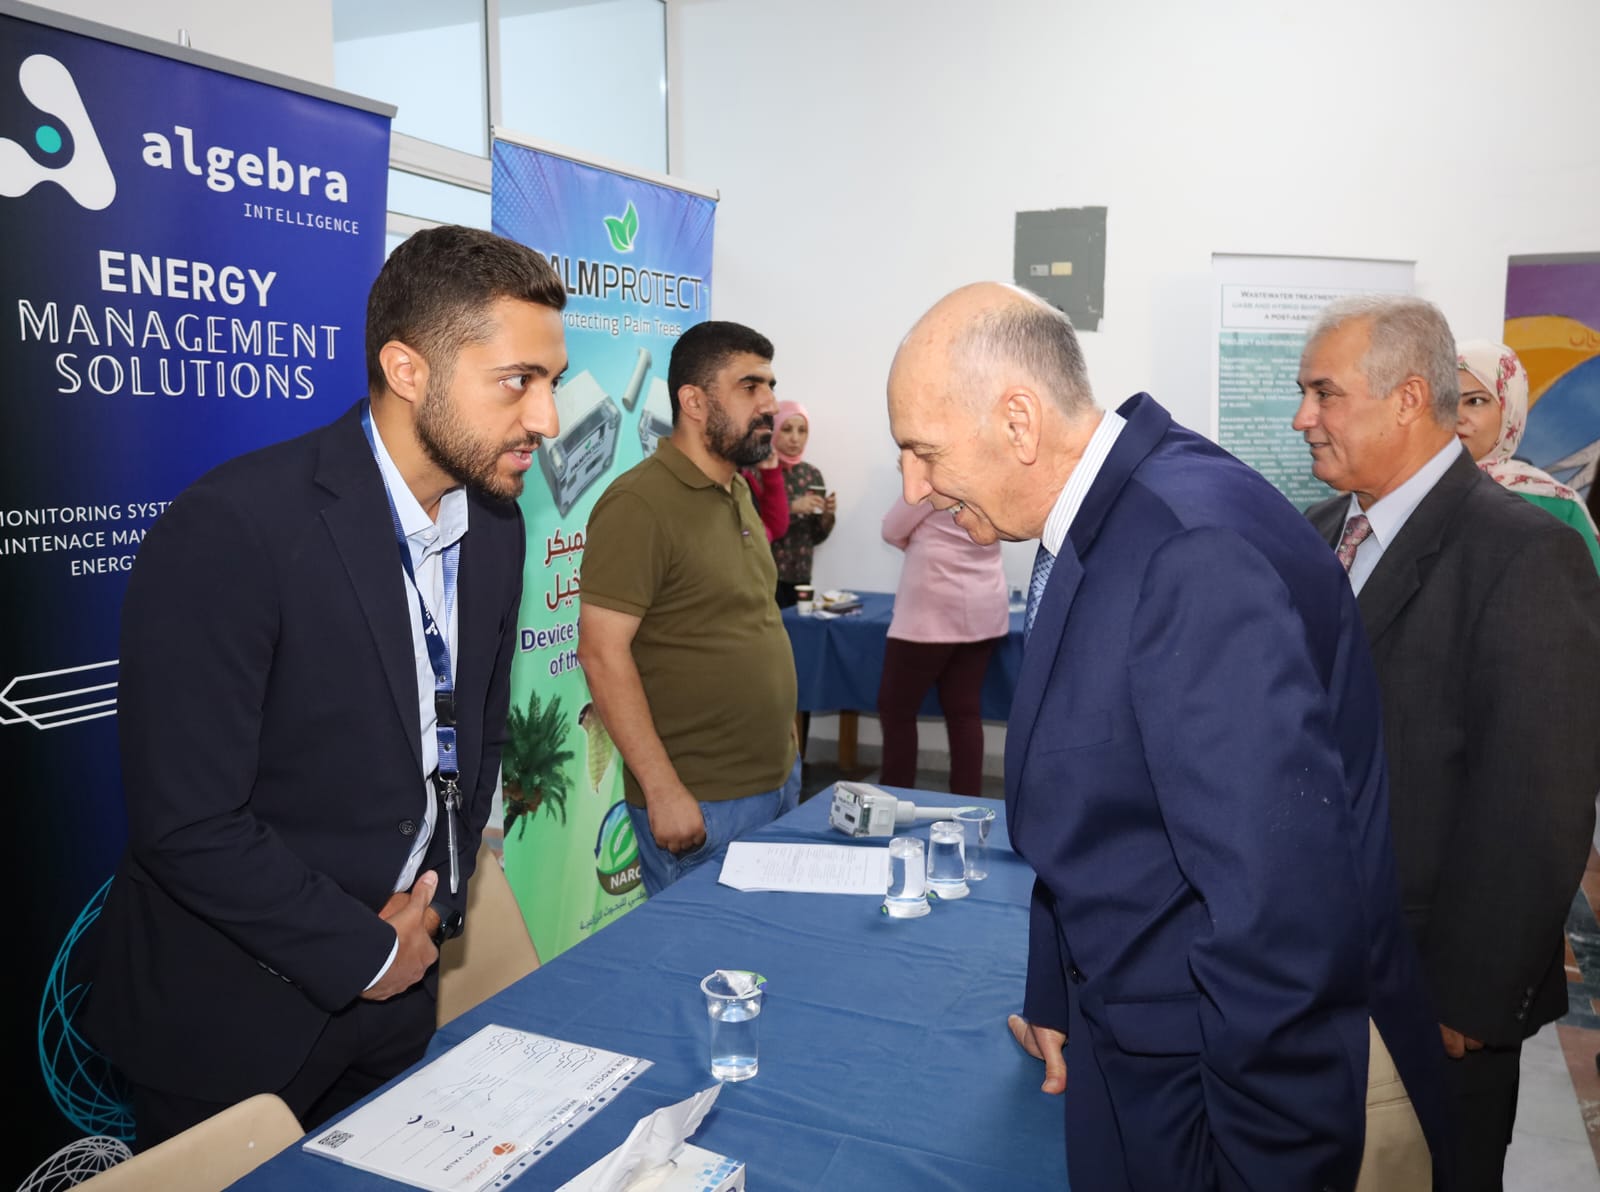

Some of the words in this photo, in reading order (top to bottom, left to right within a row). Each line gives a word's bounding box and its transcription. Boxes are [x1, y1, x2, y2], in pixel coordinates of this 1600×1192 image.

[142, 125, 348, 202] algebra
[243, 203, 360, 235] INTELLIGENCE
[99, 249, 277, 307] ENERGY
[18, 299, 341, 360] MANAGEMENT
[561, 311, 619, 336] rotecting
[624, 316, 650, 333] Palm
[655, 320, 681, 337] Trees
[56, 353, 315, 400] SOLUTIONS
[128, 501, 173, 519] SYST
[545, 527, 587, 565] مبكر
[71, 555, 136, 577] ENERG
[521, 623, 574, 651] Device
[550, 652, 563, 675] of
[567, 650, 578, 669] th
[465, 1135, 492, 1156] PRODUCT
